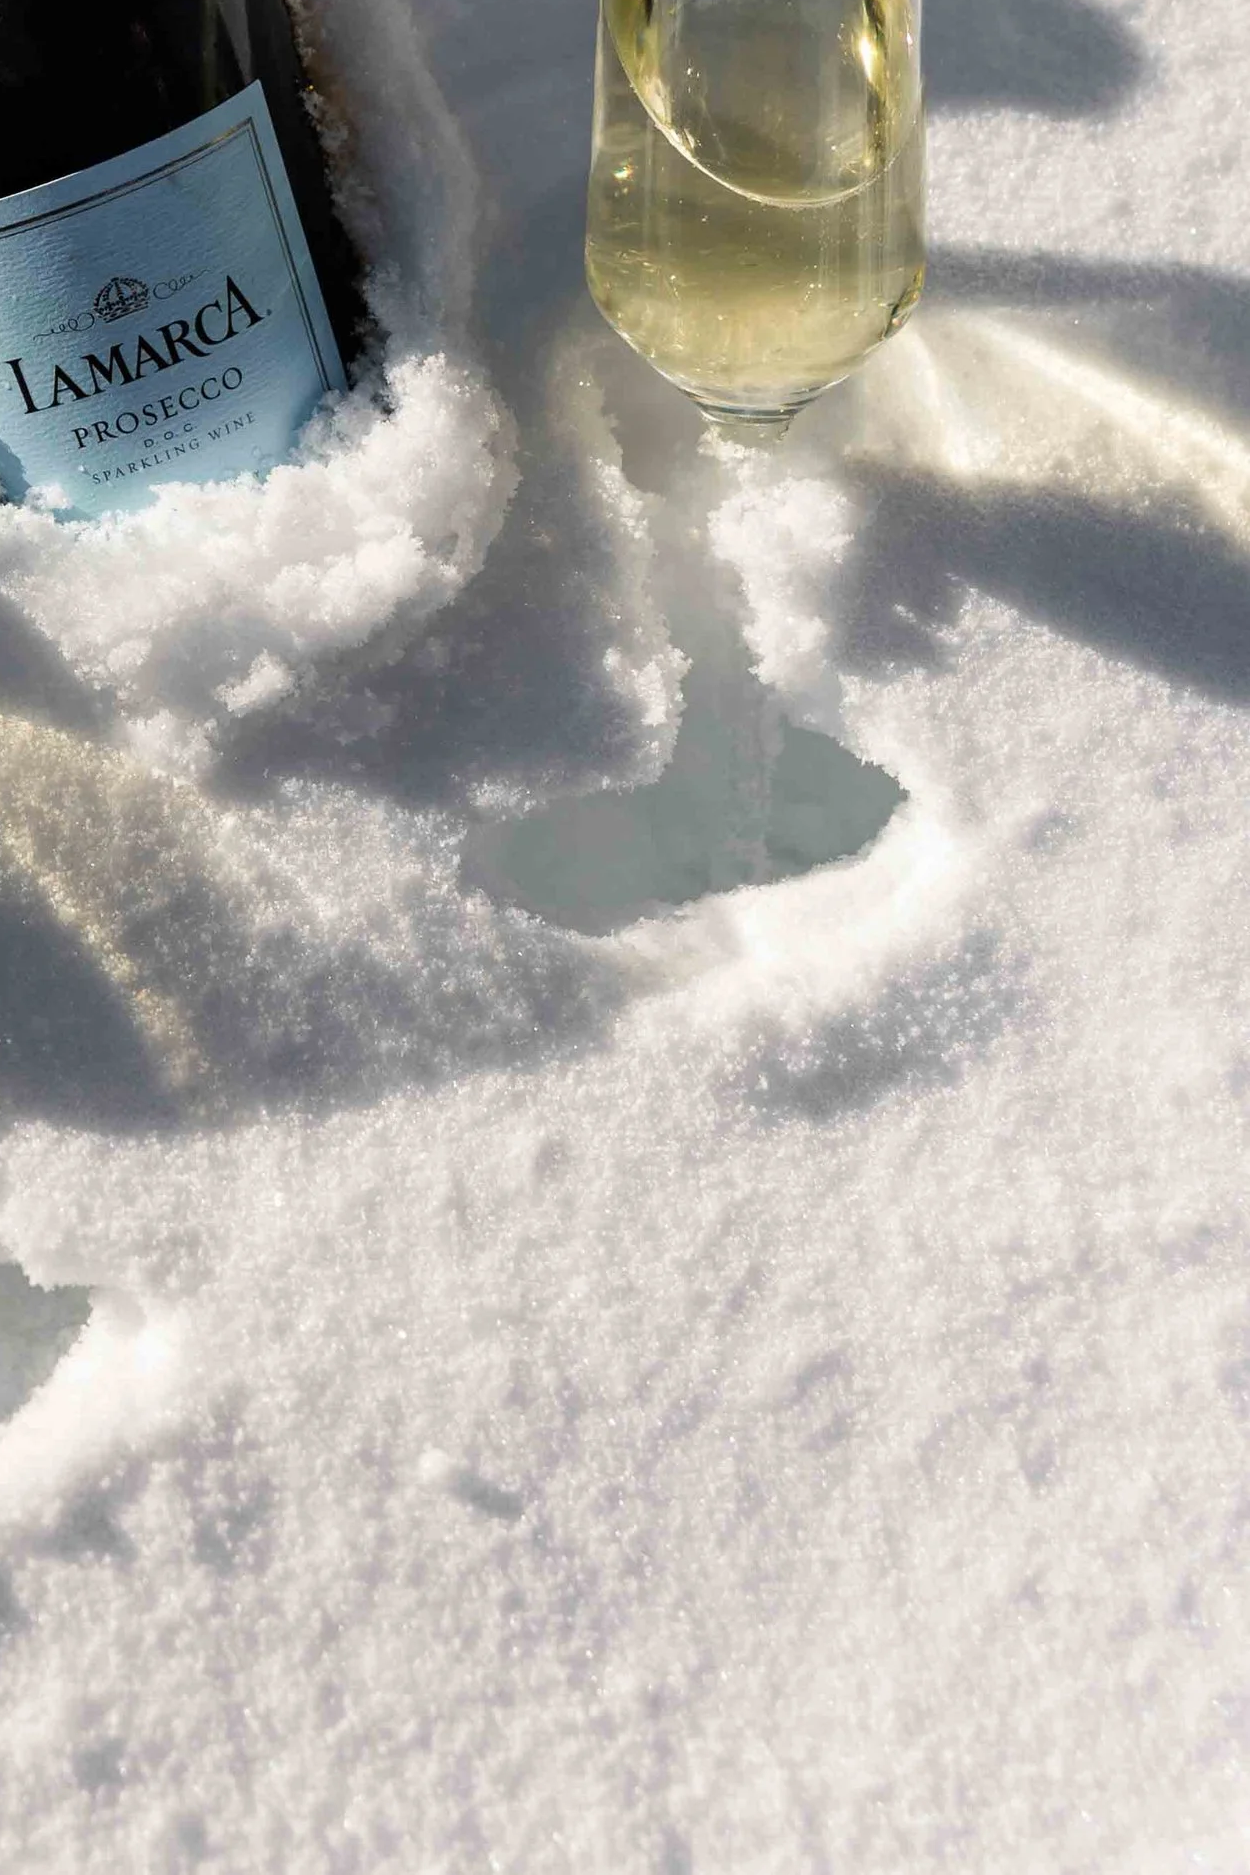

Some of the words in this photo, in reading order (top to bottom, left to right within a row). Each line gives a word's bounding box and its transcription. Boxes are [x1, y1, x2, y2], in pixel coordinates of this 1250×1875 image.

[71, 367, 243, 449] PROSECCO
[92, 438, 201, 485] SPARKLING
[207, 411, 256, 442] WINE
